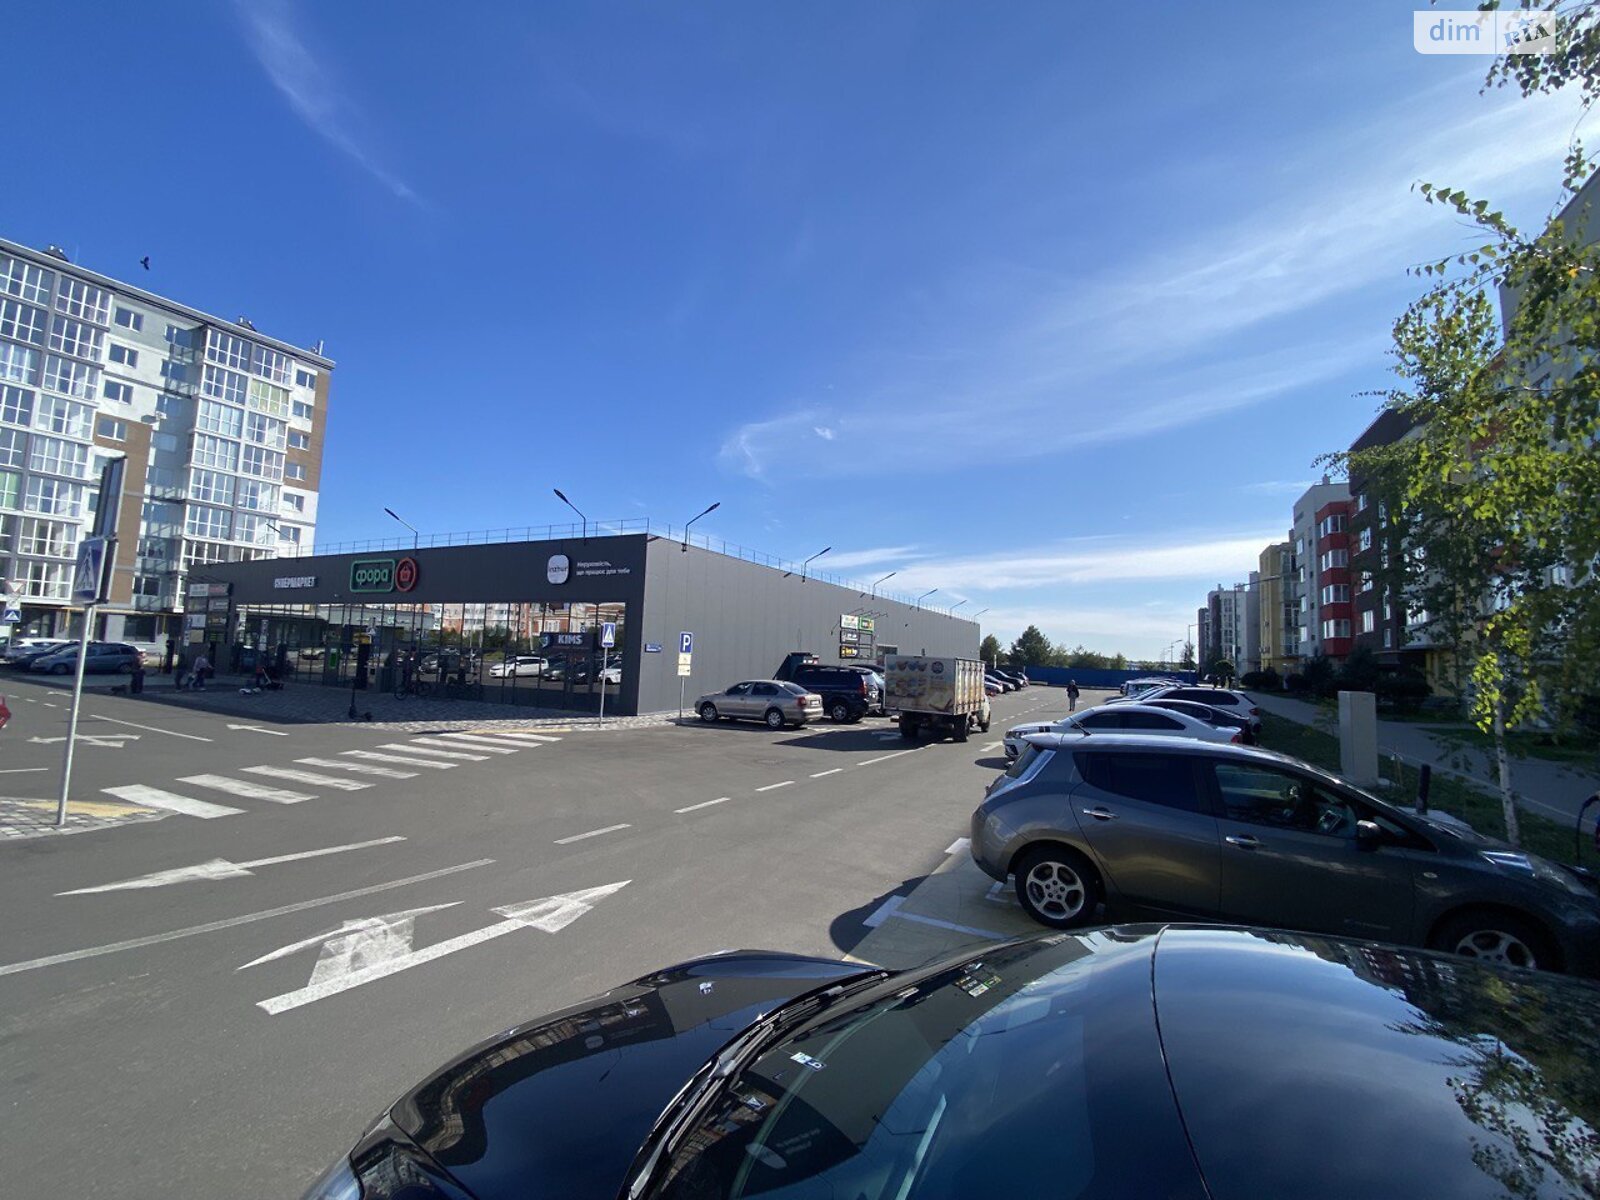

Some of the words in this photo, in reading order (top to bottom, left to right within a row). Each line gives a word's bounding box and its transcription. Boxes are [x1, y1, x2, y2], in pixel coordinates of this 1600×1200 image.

[355, 567, 389, 586] фора
[558, 634, 583, 645] KIMS
[682, 634, 691, 652] P
